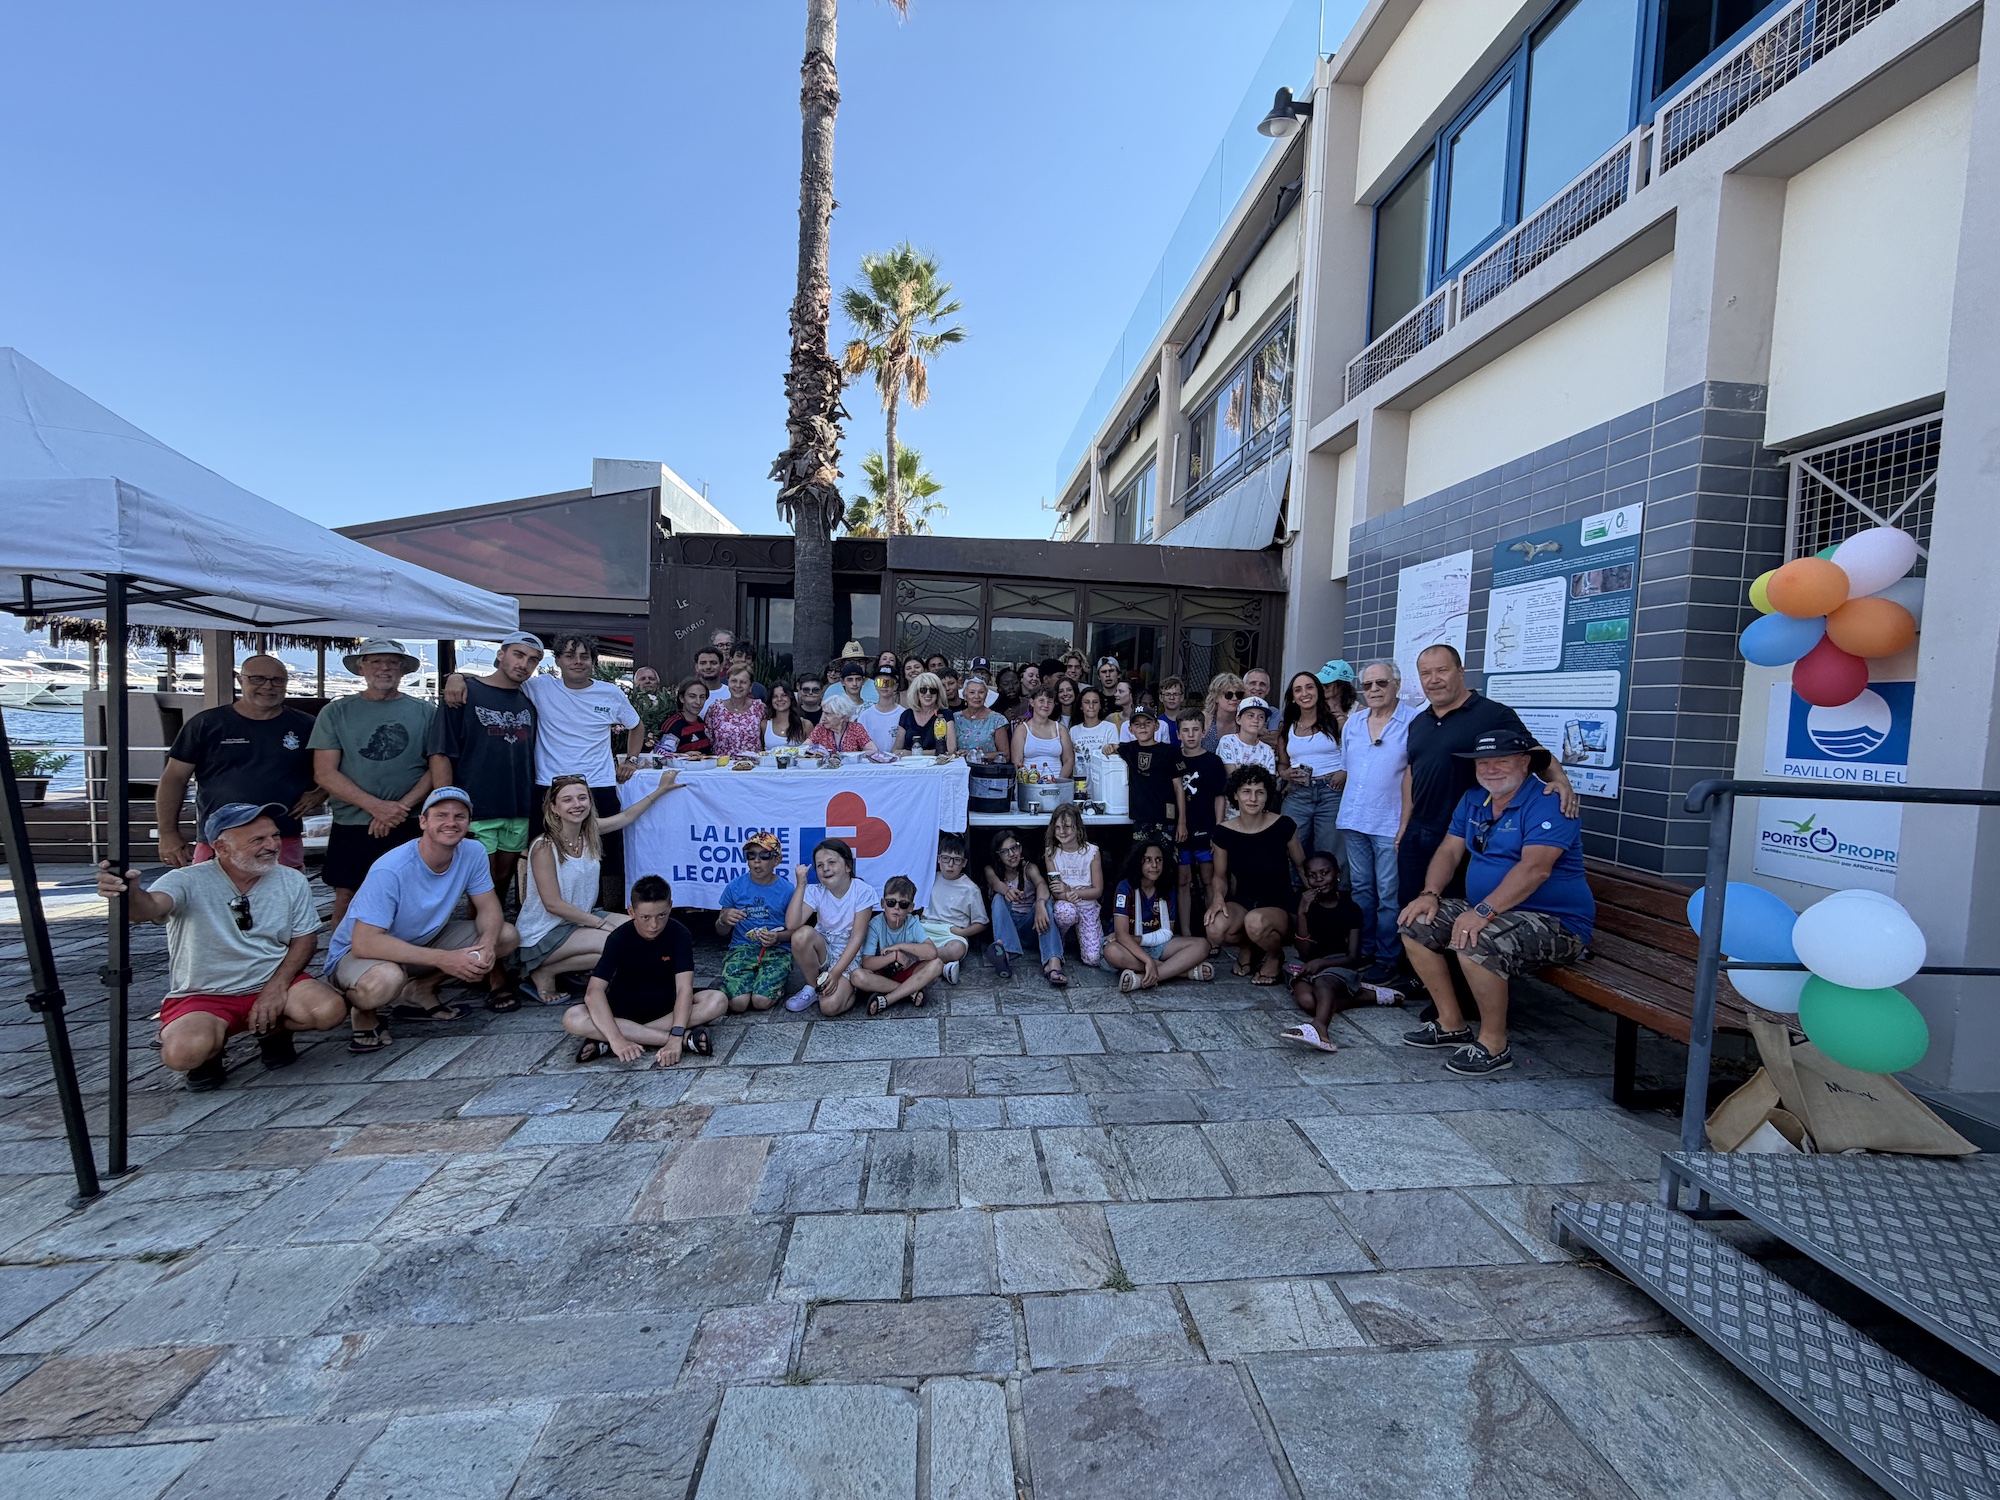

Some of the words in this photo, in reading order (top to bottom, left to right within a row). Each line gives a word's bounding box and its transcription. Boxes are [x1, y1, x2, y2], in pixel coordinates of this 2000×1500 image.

[676, 599, 689, 609] LE
[674, 619, 705, 640] BARRIO
[1783, 764, 1857, 780] PAVILLON
[1862, 769, 1907, 784] BLEU
[690, 824, 719, 842] LA
[724, 826, 790, 844] LIGE
[1762, 830, 1808, 848] PORTS
[699, 845, 790, 864] CONE
[673, 865, 698, 882] LE
[701, 866, 790, 884] CANR
